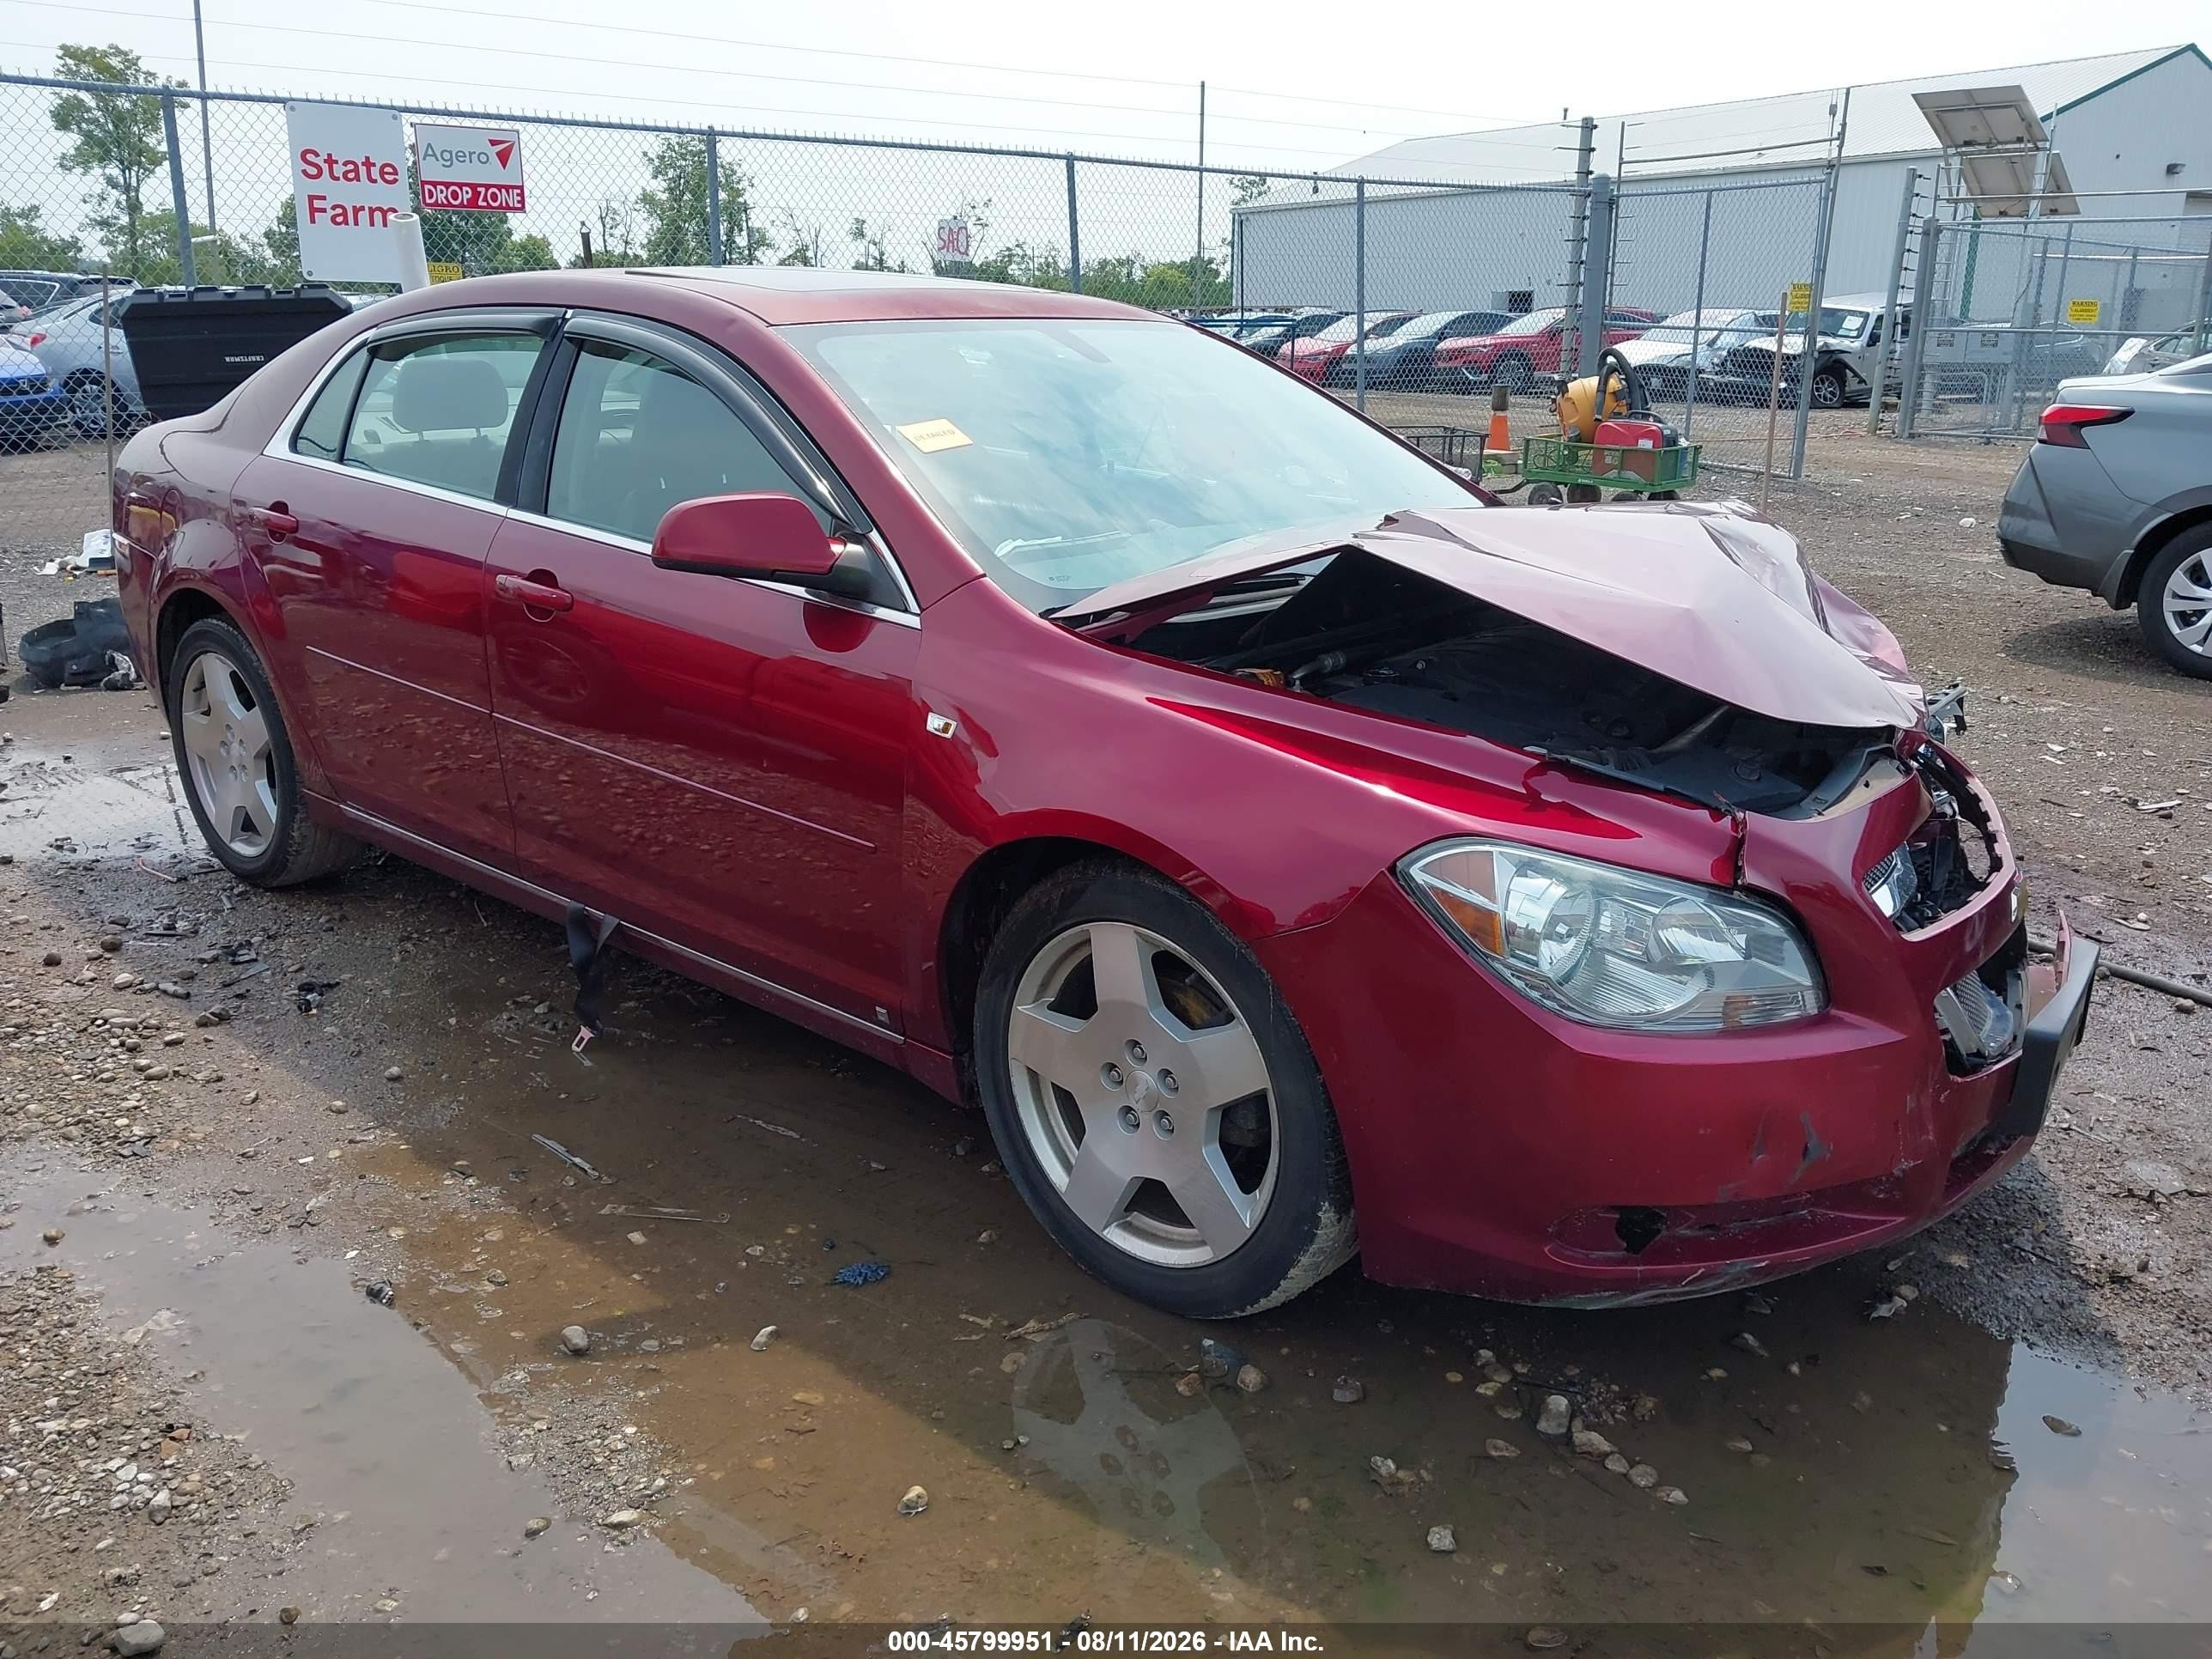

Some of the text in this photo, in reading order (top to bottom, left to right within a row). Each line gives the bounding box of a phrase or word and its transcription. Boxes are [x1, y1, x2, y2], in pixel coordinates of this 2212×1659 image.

[300, 148, 399, 185] State
[422, 142, 490, 168] Agero
[307, 194, 399, 228] Farm
[424, 184, 522, 208] DROP ZONE
